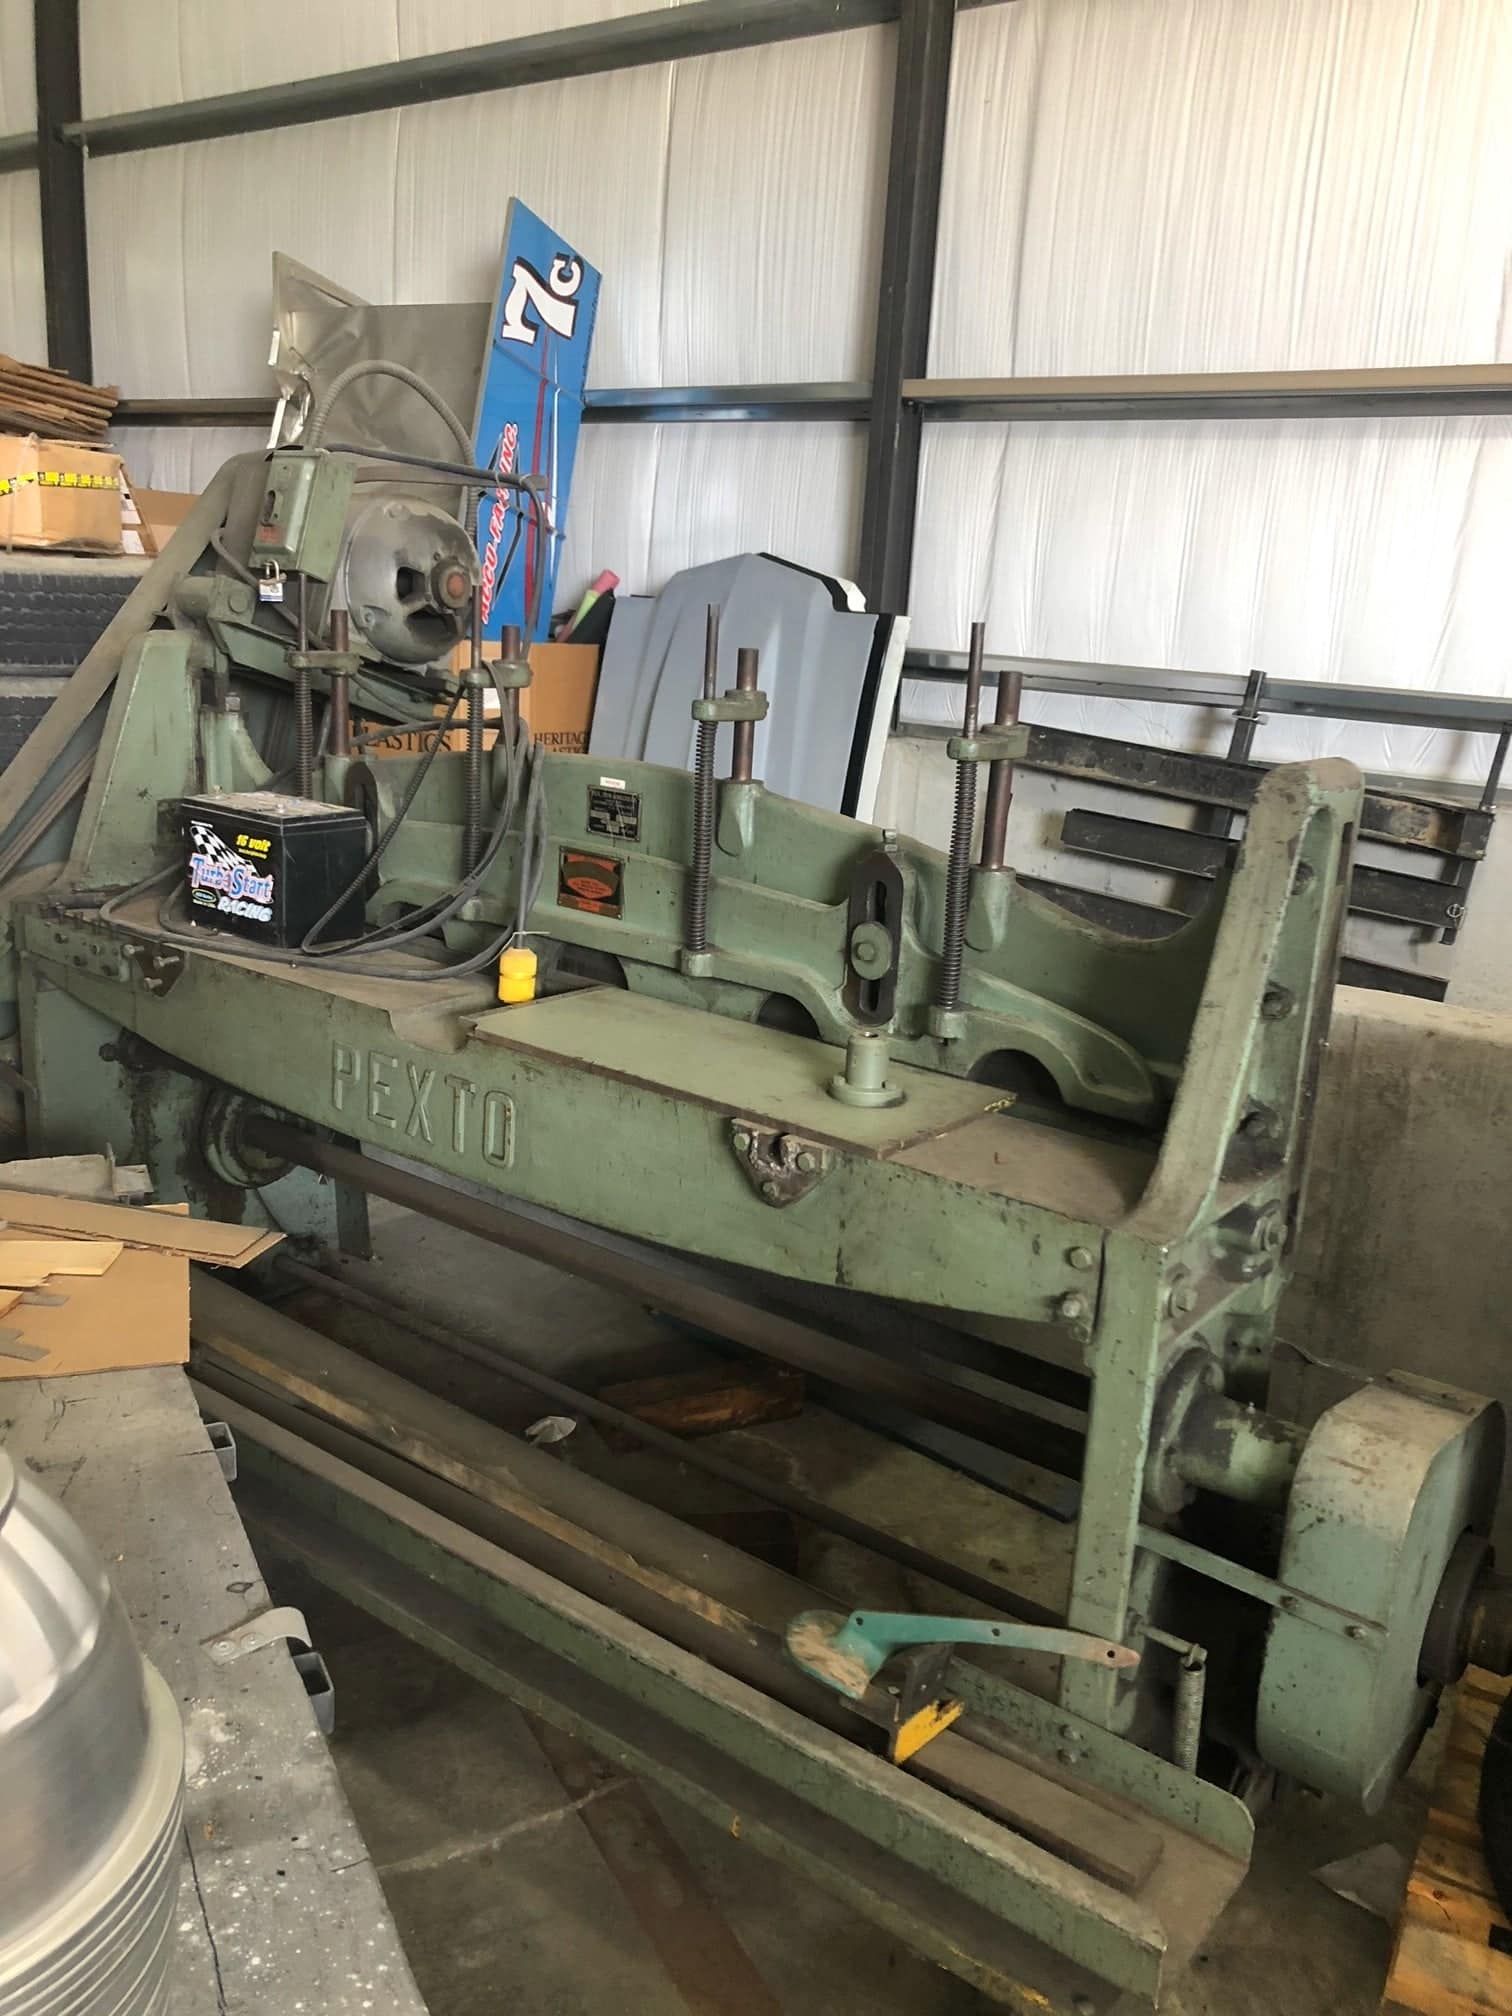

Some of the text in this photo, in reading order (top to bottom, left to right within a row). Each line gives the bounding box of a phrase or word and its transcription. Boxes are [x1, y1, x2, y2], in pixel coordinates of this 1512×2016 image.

[354, 725, 452, 752] ASTICS
[534, 732, 588, 745] HERITAG
[217, 896, 273, 922] RACING
[331, 1039, 515, 1170] PEXTO
